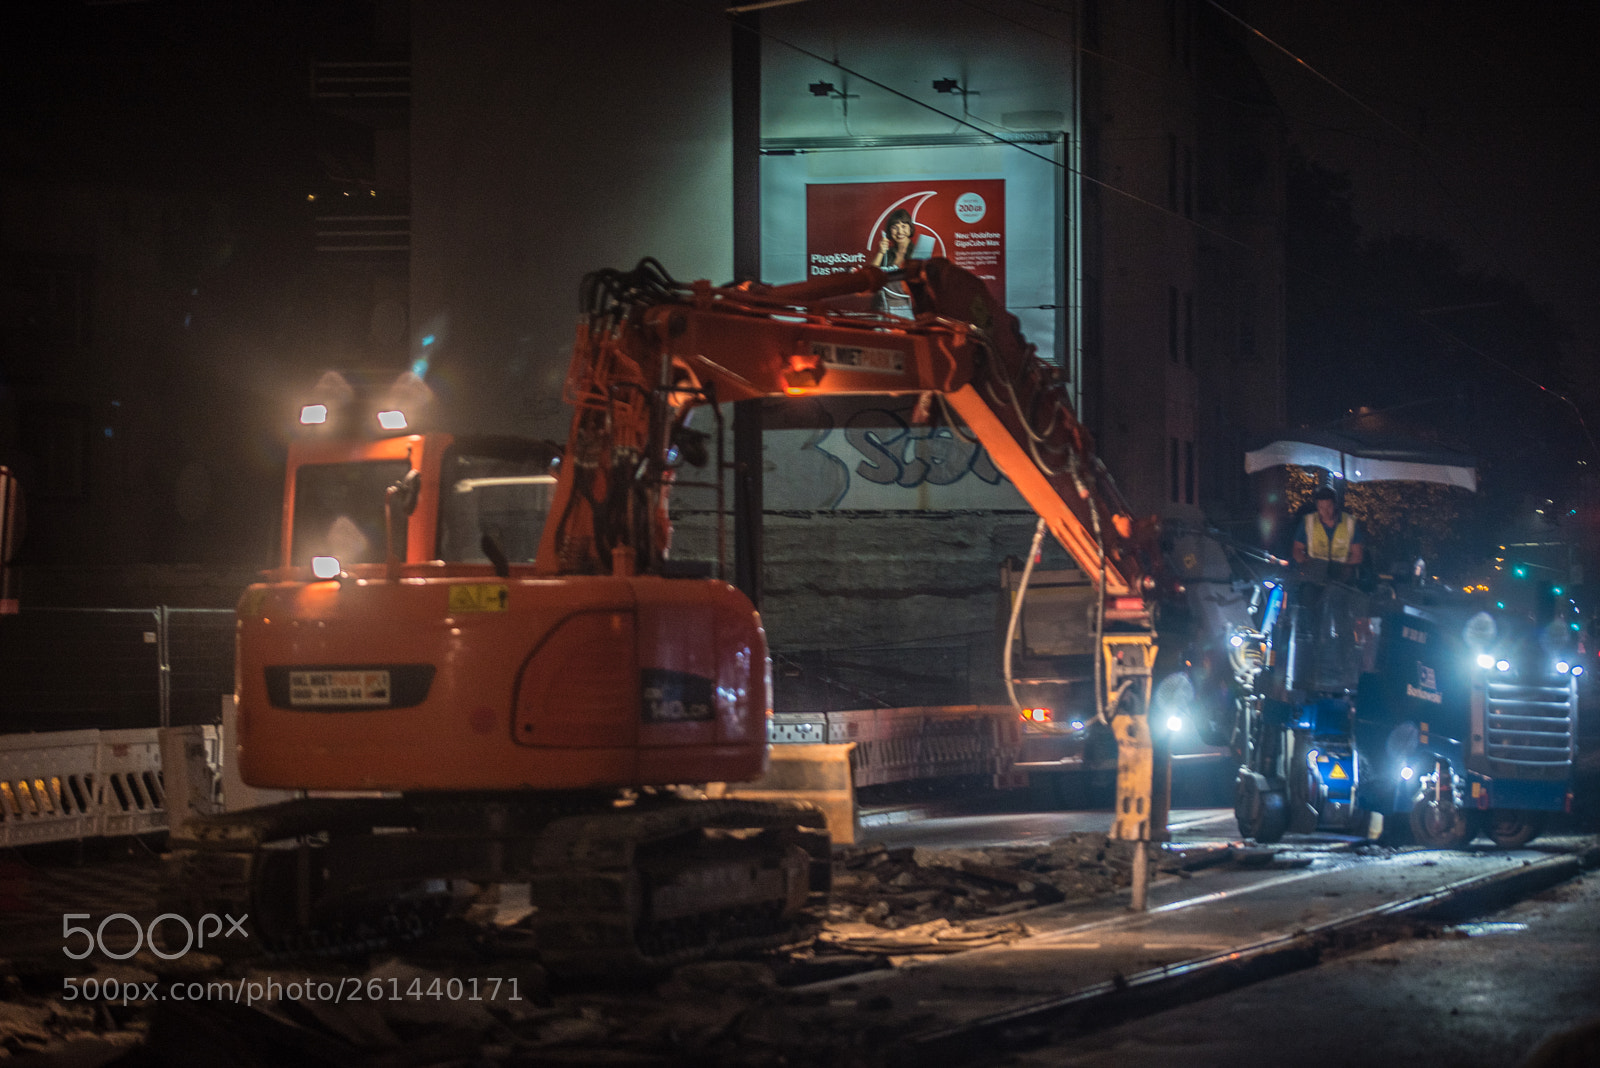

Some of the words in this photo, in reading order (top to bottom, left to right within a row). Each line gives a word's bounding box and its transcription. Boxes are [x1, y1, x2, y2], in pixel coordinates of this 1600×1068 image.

[959, 204, 974, 212] 200
[970, 231, 1001, 239] Vodafone
[954, 240, 986, 248] GigaCube
[810, 252, 866, 265] Plug&Surf:
[810, 265, 831, 275] Das
